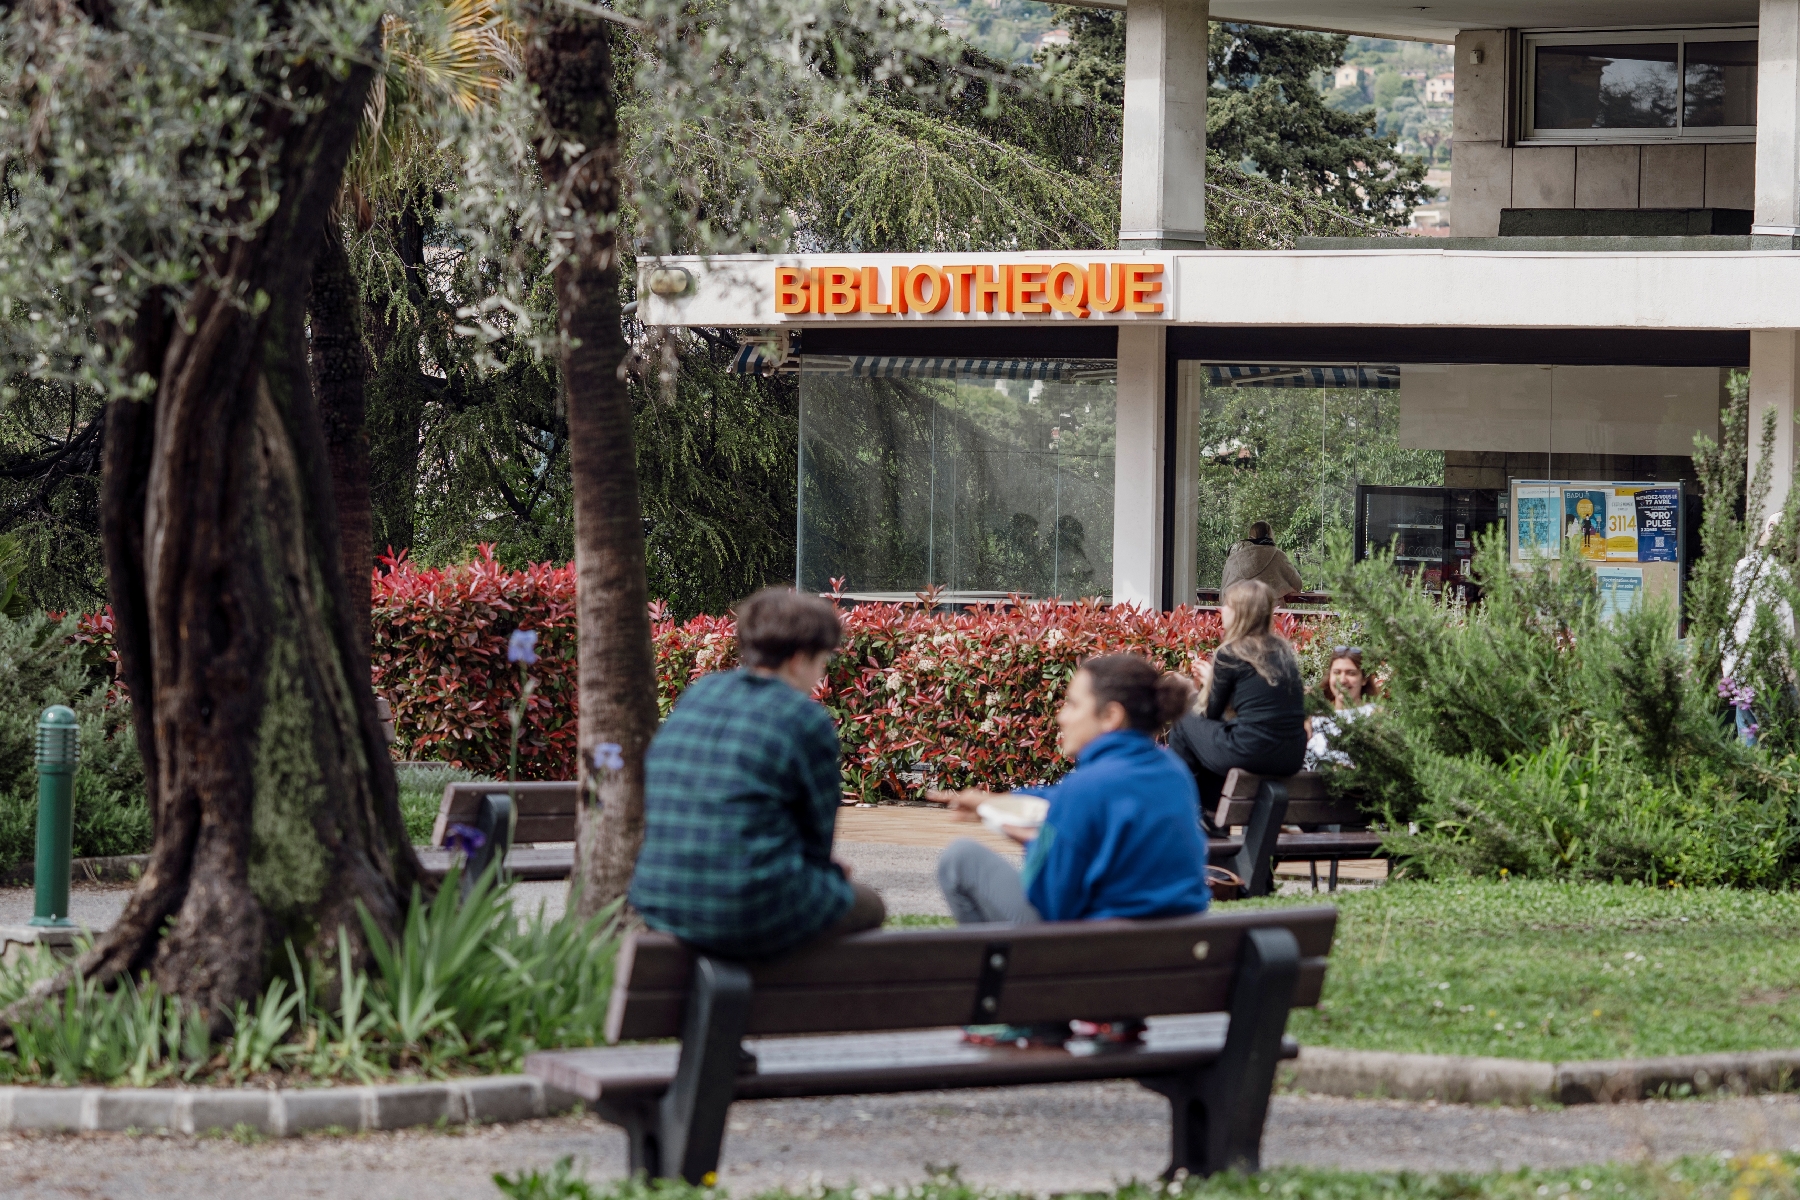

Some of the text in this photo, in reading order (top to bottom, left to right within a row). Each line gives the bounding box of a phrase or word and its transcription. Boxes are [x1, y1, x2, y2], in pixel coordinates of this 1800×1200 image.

[775, 263, 1164, 318] BIBLIOTHEQUE
[1609, 515, 1637, 532] 3114
[1645, 519, 1672, 528] PULSE
